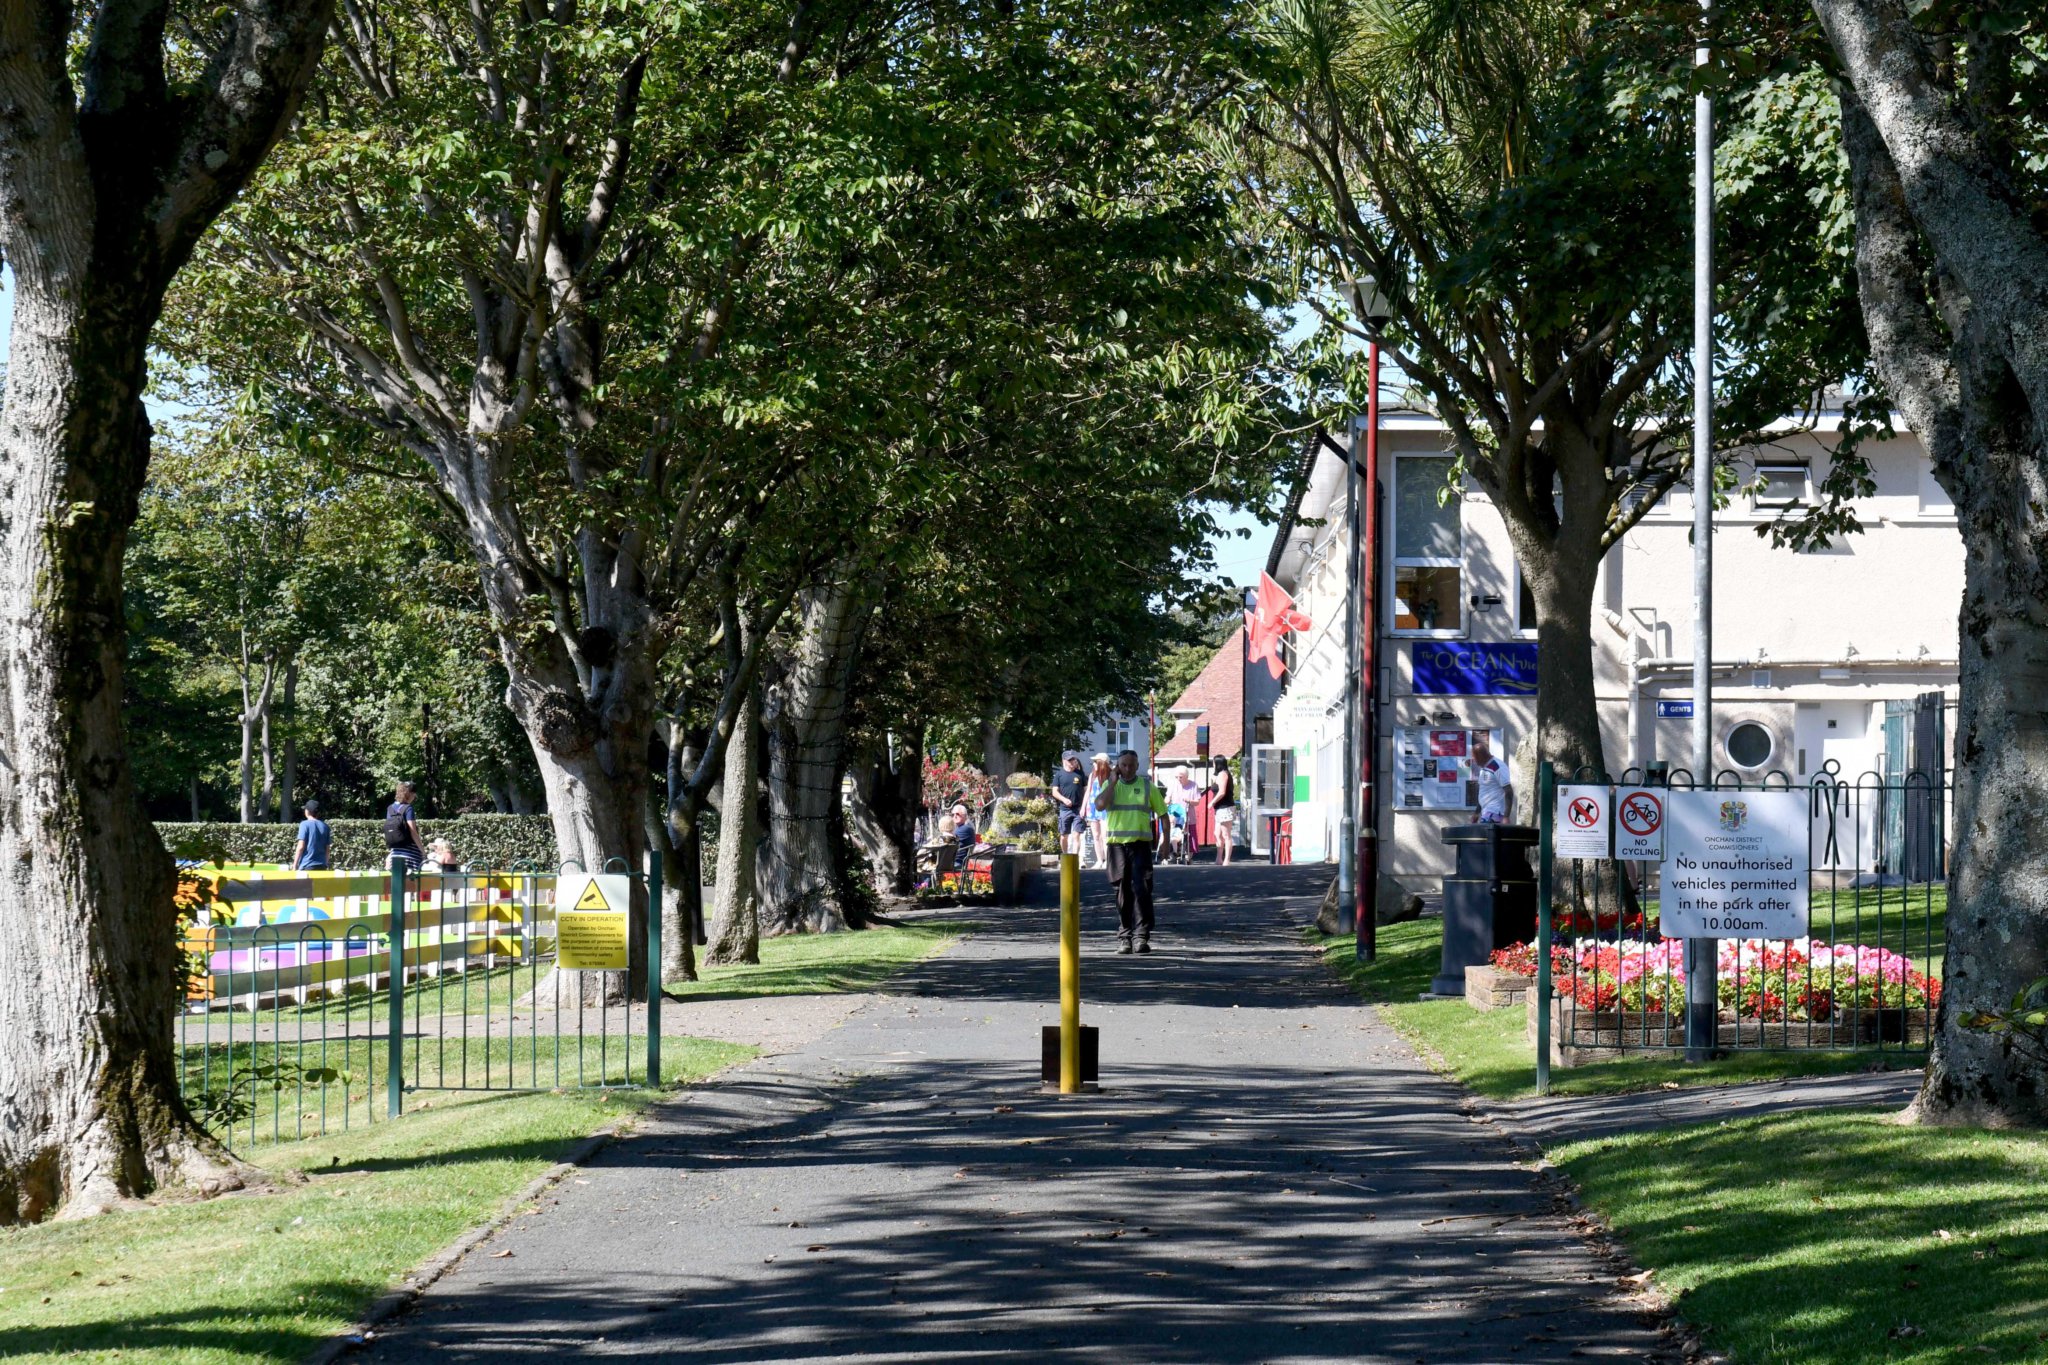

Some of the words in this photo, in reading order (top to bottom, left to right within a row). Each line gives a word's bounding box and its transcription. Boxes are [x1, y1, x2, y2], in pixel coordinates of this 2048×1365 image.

[1421, 651, 1433, 660] The
[1434, 651, 1516, 670] OCEAN
[1516, 658, 1538, 671] Vie
[1670, 705, 1692, 713] GENTS
[1634, 838, 1648, 846] NO
[1621, 847, 1660, 856] CYCLING
[1676, 857, 1697, 870] No
[1702, 857, 1793, 870] unauthorised
[1671, 877, 1726, 890] vehicles
[1731, 878, 1797, 893] permitted
[1678, 897, 1691, 909] in
[1696, 897, 1718, 910] the
[1723, 897, 1754, 912] park
[1758, 897, 1791, 910] after
[1702, 917, 1768, 930] 10.00am.
